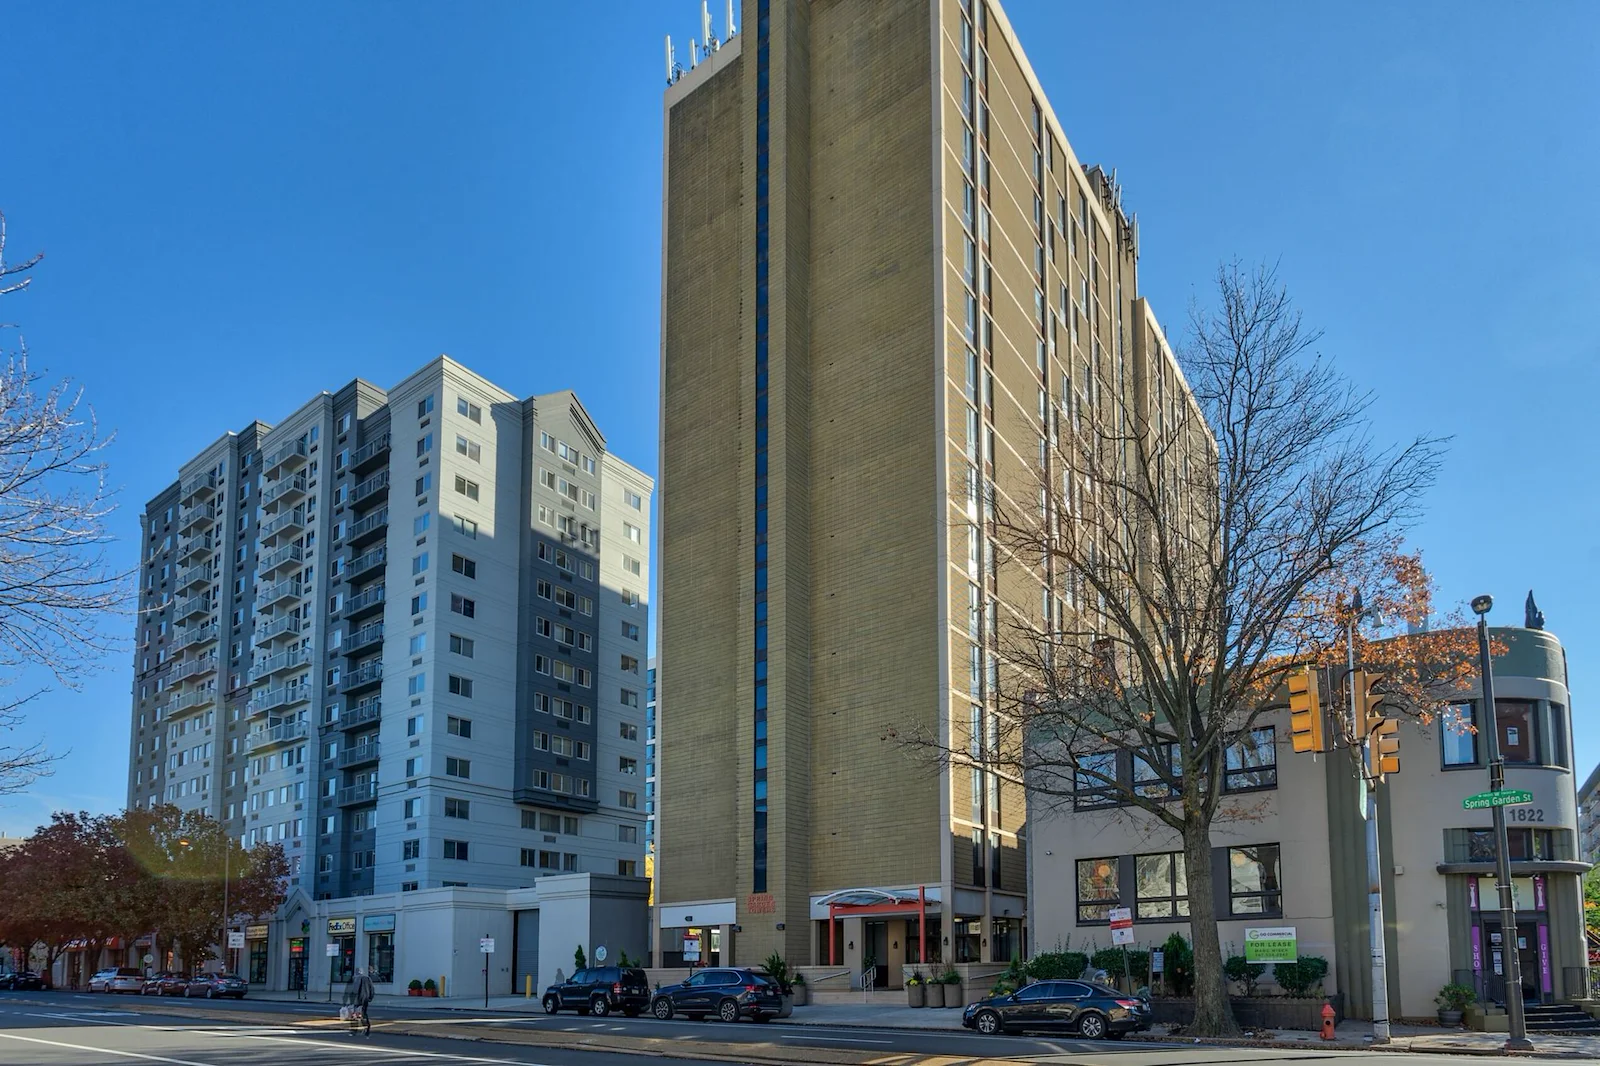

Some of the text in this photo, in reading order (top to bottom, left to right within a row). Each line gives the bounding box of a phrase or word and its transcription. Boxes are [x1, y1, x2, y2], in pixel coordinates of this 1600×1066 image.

[1465, 793, 1532, 809] Spring Garden St
[1509, 808, 1544, 822] 1822
[329, 922, 342, 931] FedEx
[342, 921, 355, 930] Office
[1540, 943, 1549, 974] GIVE
